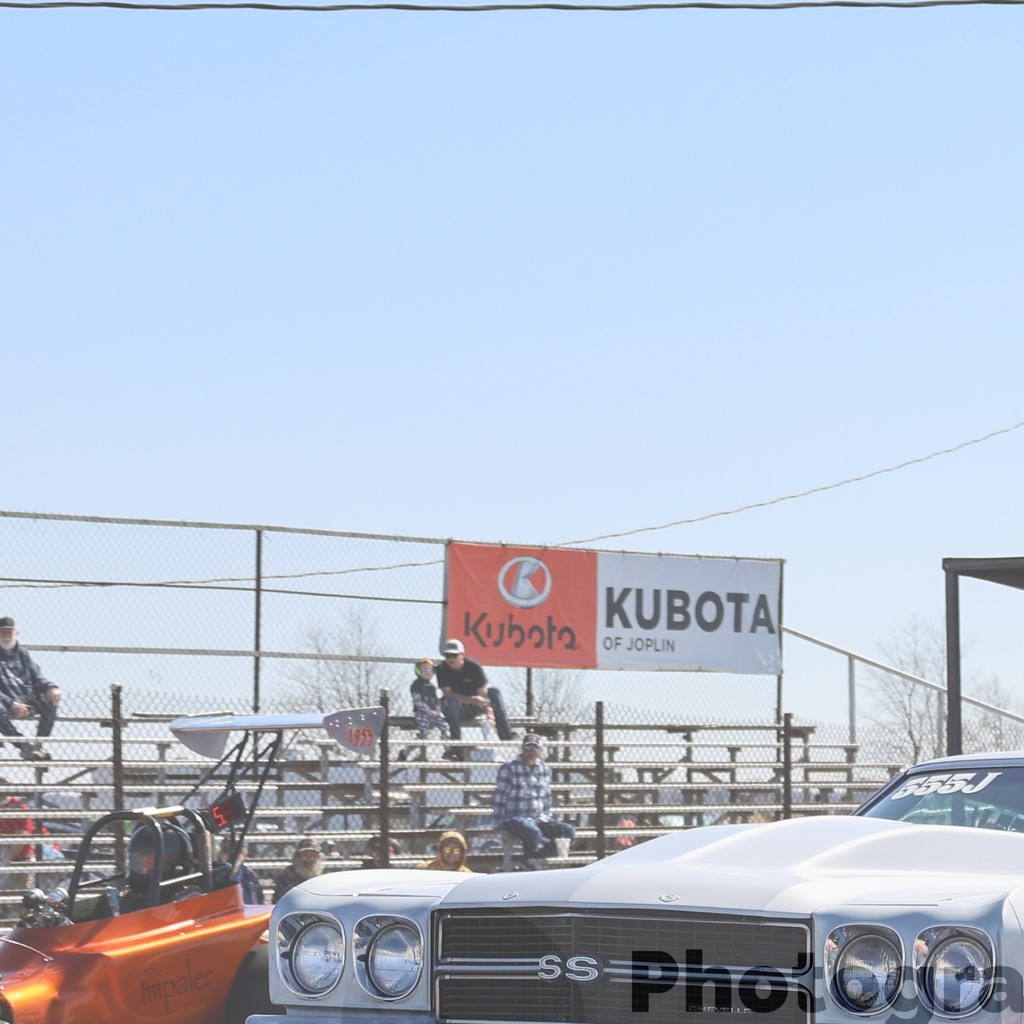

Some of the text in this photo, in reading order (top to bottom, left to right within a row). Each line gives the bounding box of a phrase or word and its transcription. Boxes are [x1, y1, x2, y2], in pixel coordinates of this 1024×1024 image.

[605, 586, 776, 635] KUBOTA
[464, 611, 576, 650] Kubota
[603, 636, 675, 653] OF JOPLIN
[891, 772, 1003, 800] 555J
[538, 954, 599, 981] SS
[140, 959, 213, 1015] Impaler
